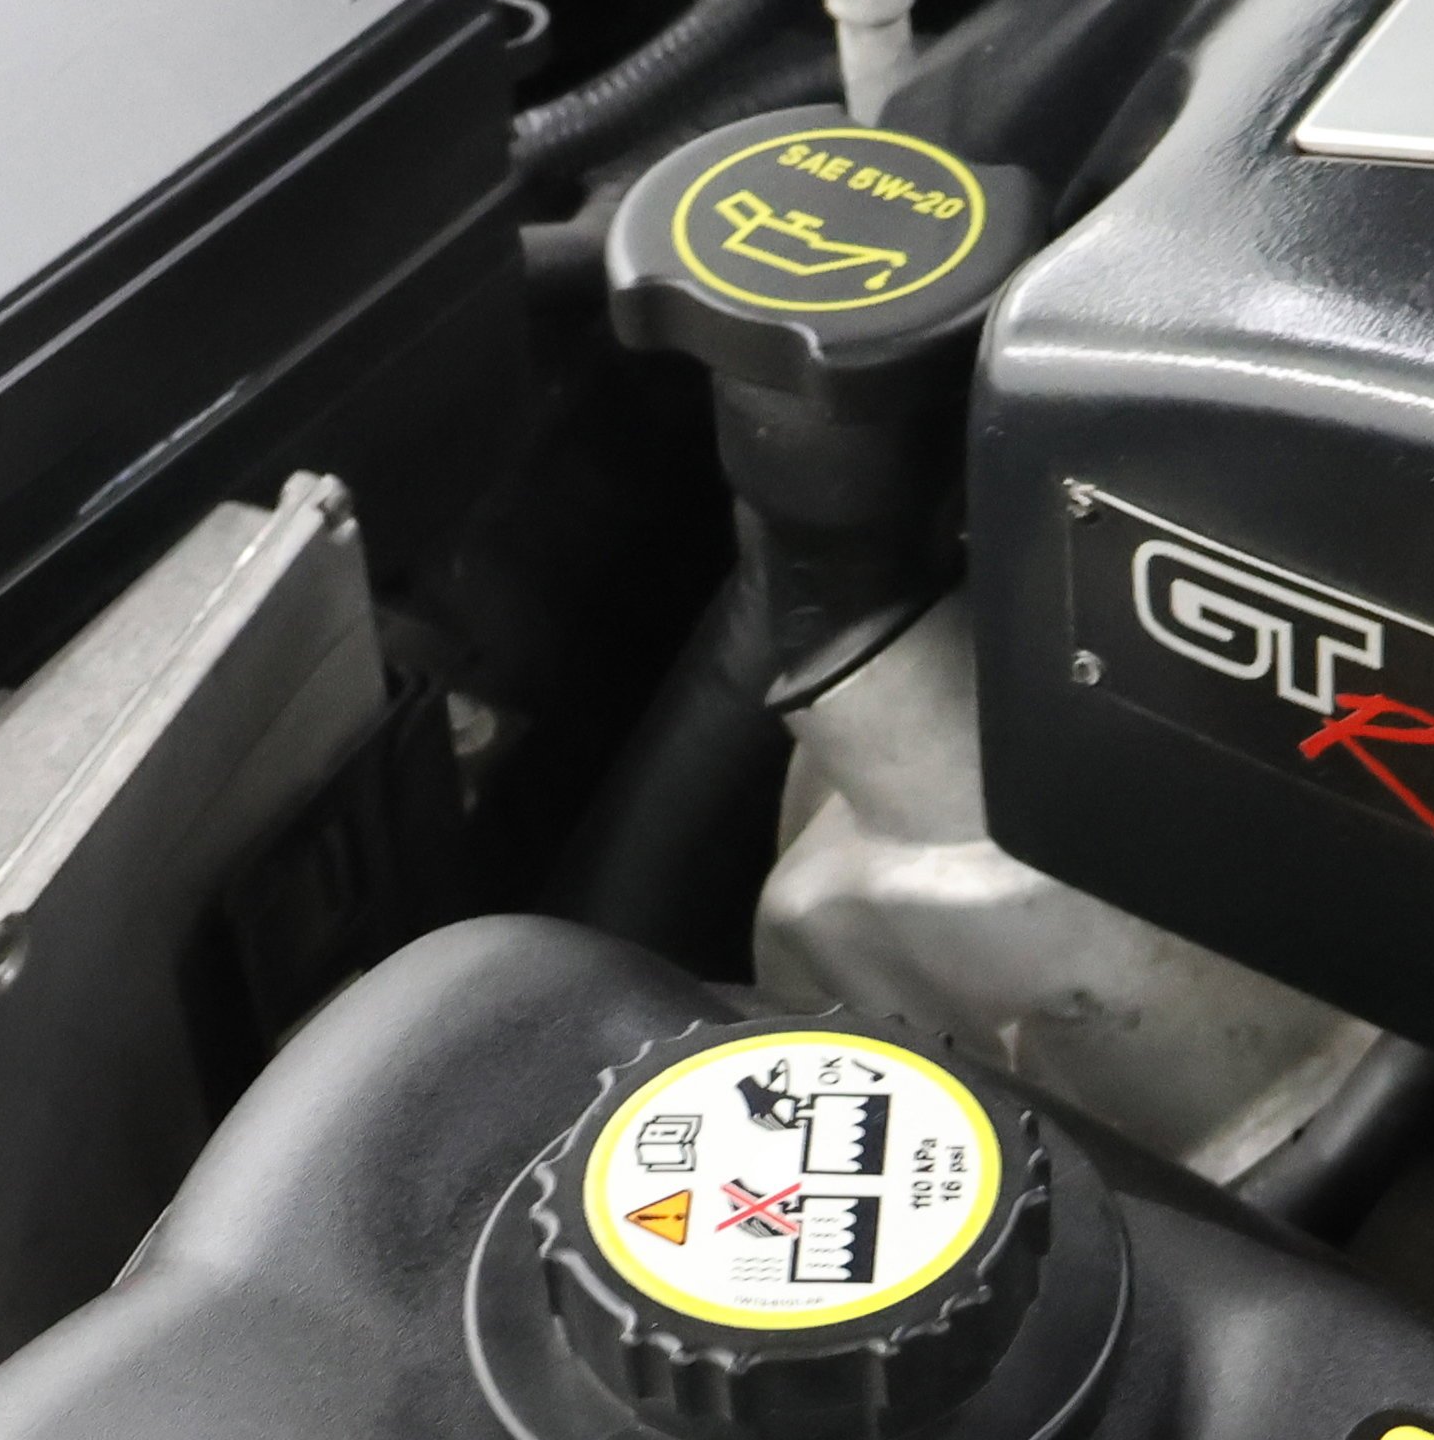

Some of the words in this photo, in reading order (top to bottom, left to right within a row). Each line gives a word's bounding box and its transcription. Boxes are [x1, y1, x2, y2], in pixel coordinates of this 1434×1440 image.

[777, 144, 853, 181] SAE
[848, 166, 965, 219] 5W-20
[819, 1056, 843, 1085] OK
[913, 1137, 938, 1174] kPa
[949, 1145, 967, 1174] psi
[910, 1180, 934, 1211] 110
[941, 1179, 963, 1204] 16
